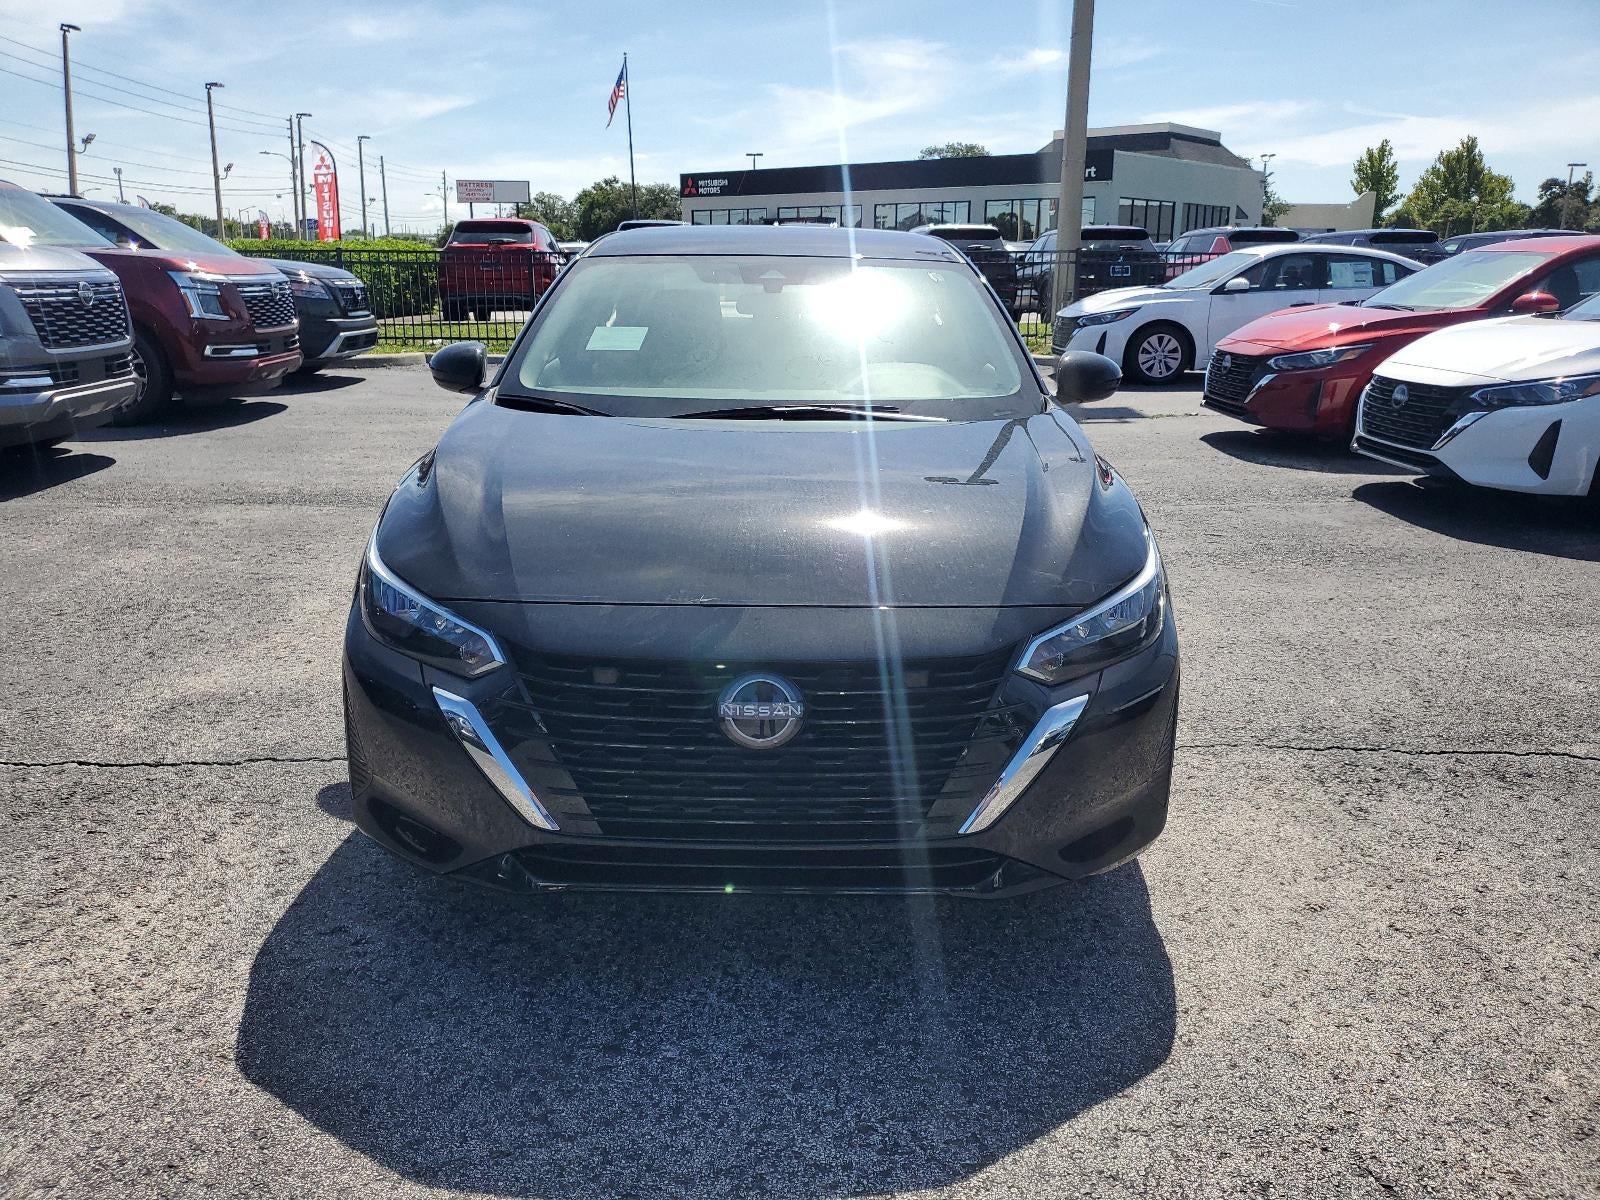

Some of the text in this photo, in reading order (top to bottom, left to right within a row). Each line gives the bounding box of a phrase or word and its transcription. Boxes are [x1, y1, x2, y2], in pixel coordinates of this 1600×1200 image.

[1085, 166, 1097, 178] rt
[698, 179, 728, 187] MITSUBISHI
[720, 703, 801, 716] NISSAN
